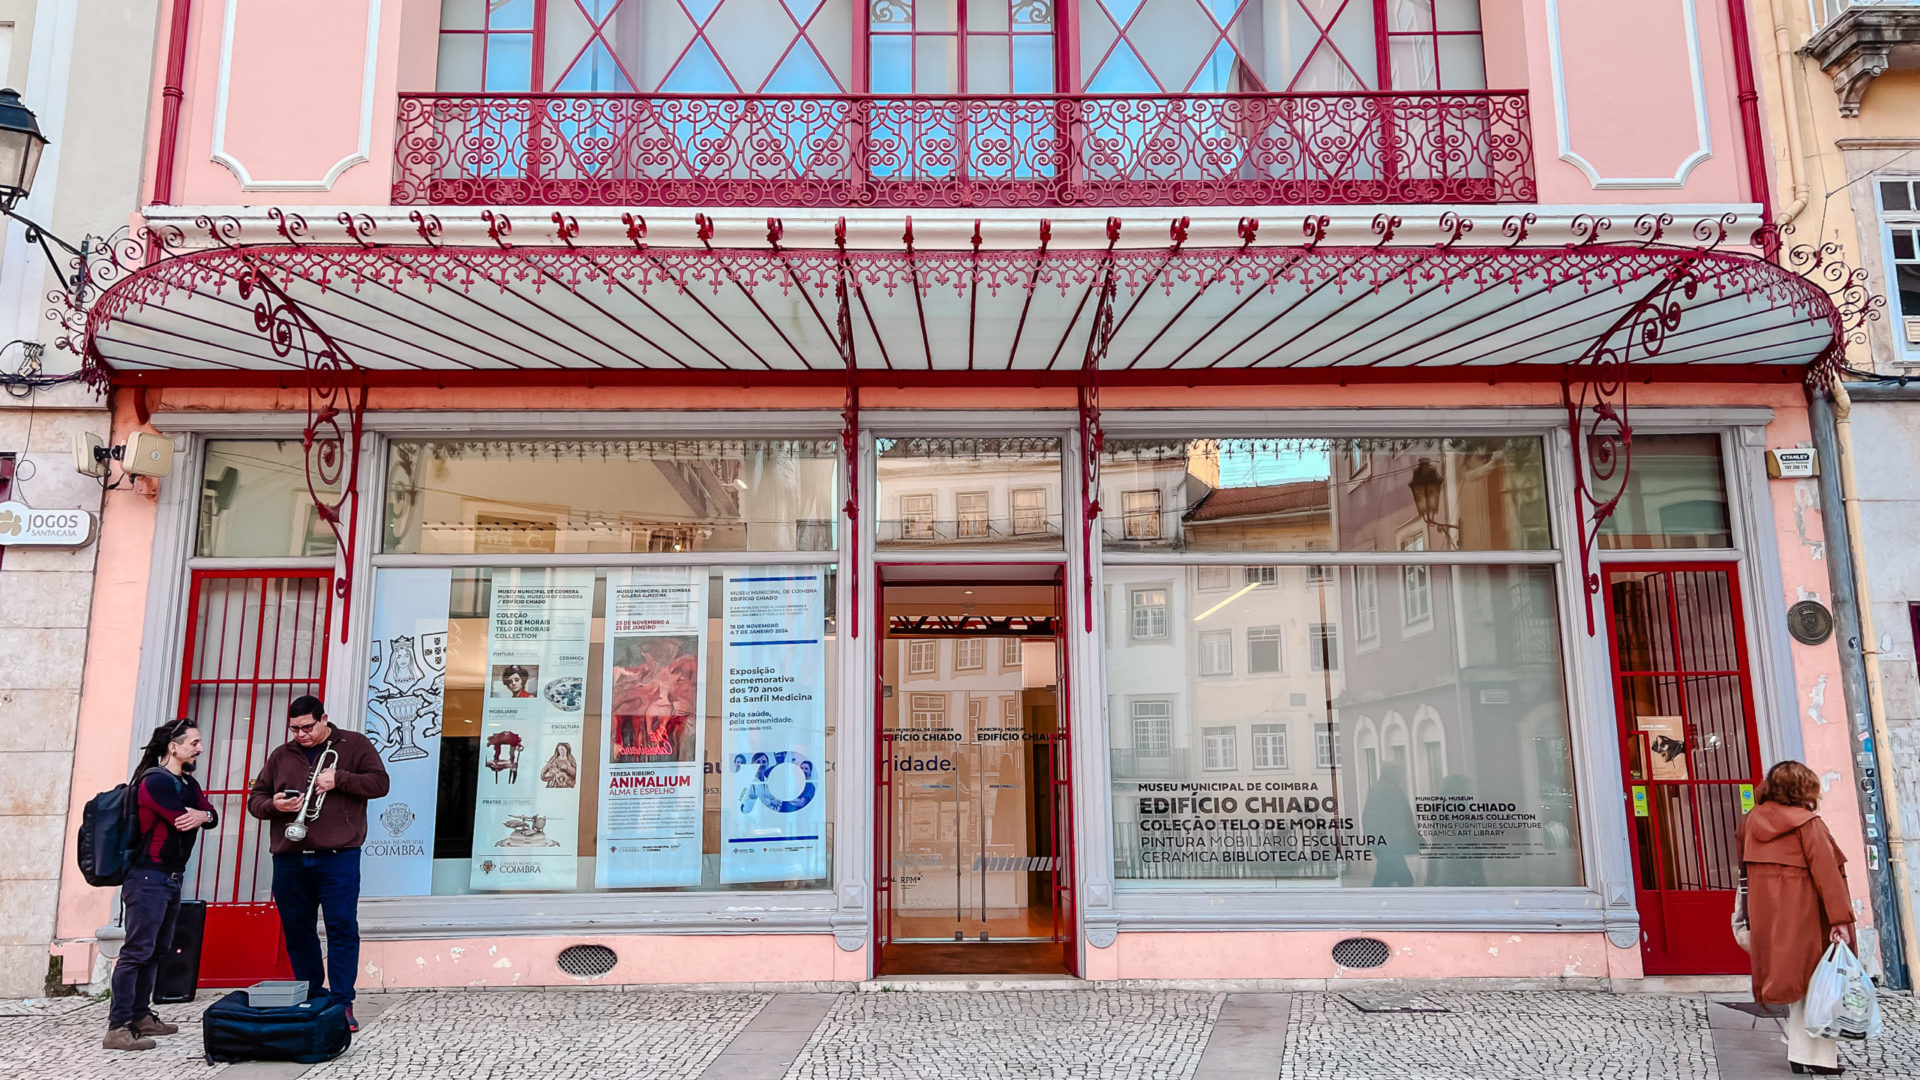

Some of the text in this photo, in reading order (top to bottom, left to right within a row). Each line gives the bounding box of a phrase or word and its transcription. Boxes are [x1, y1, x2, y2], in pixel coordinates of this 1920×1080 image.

[26, 514, 78, 532] JOGOS
[31, 529, 77, 537] SANTACASA
[496, 611, 528, 619] COLEÇÃO
[730, 667, 776, 676] Exposição
[730, 675, 795, 684] comemorativa
[729, 686, 746, 694] dos
[743, 694, 770, 703] Sanfil
[771, 693, 812, 702] Medicina
[729, 716, 793, 726] pela comunidade.
[922, 733, 962, 741] CHIADO
[977, 731, 1020, 741] EDIFÍCIO
[609, 775, 691, 788] ANIMALIUM
[609, 788, 631, 796] ALMA
[640, 787, 675, 795] ESPELHO
[1138, 782, 1318, 792] MUSEU MUNICIPAL DE COIMBRA
[1140, 790, 1338, 814] EDIFÍCIO CHIADO
[1416, 801, 1516, 813] EDIFÍCIO CHIADO
[1140, 815, 1354, 834] COLEÇÃO TELO DE MORAIS
[1141, 832, 1388, 848] PINTURA MOBILIÁRIO ESCULTURA
[365, 845, 425, 856] COIMBRA
[1222, 850, 1308, 862] BIBLIOTECA
[1311, 850, 1330, 861] DE
[1334, 850, 1373, 861] ARTE
[499, 865, 542, 873] COIMBRA
